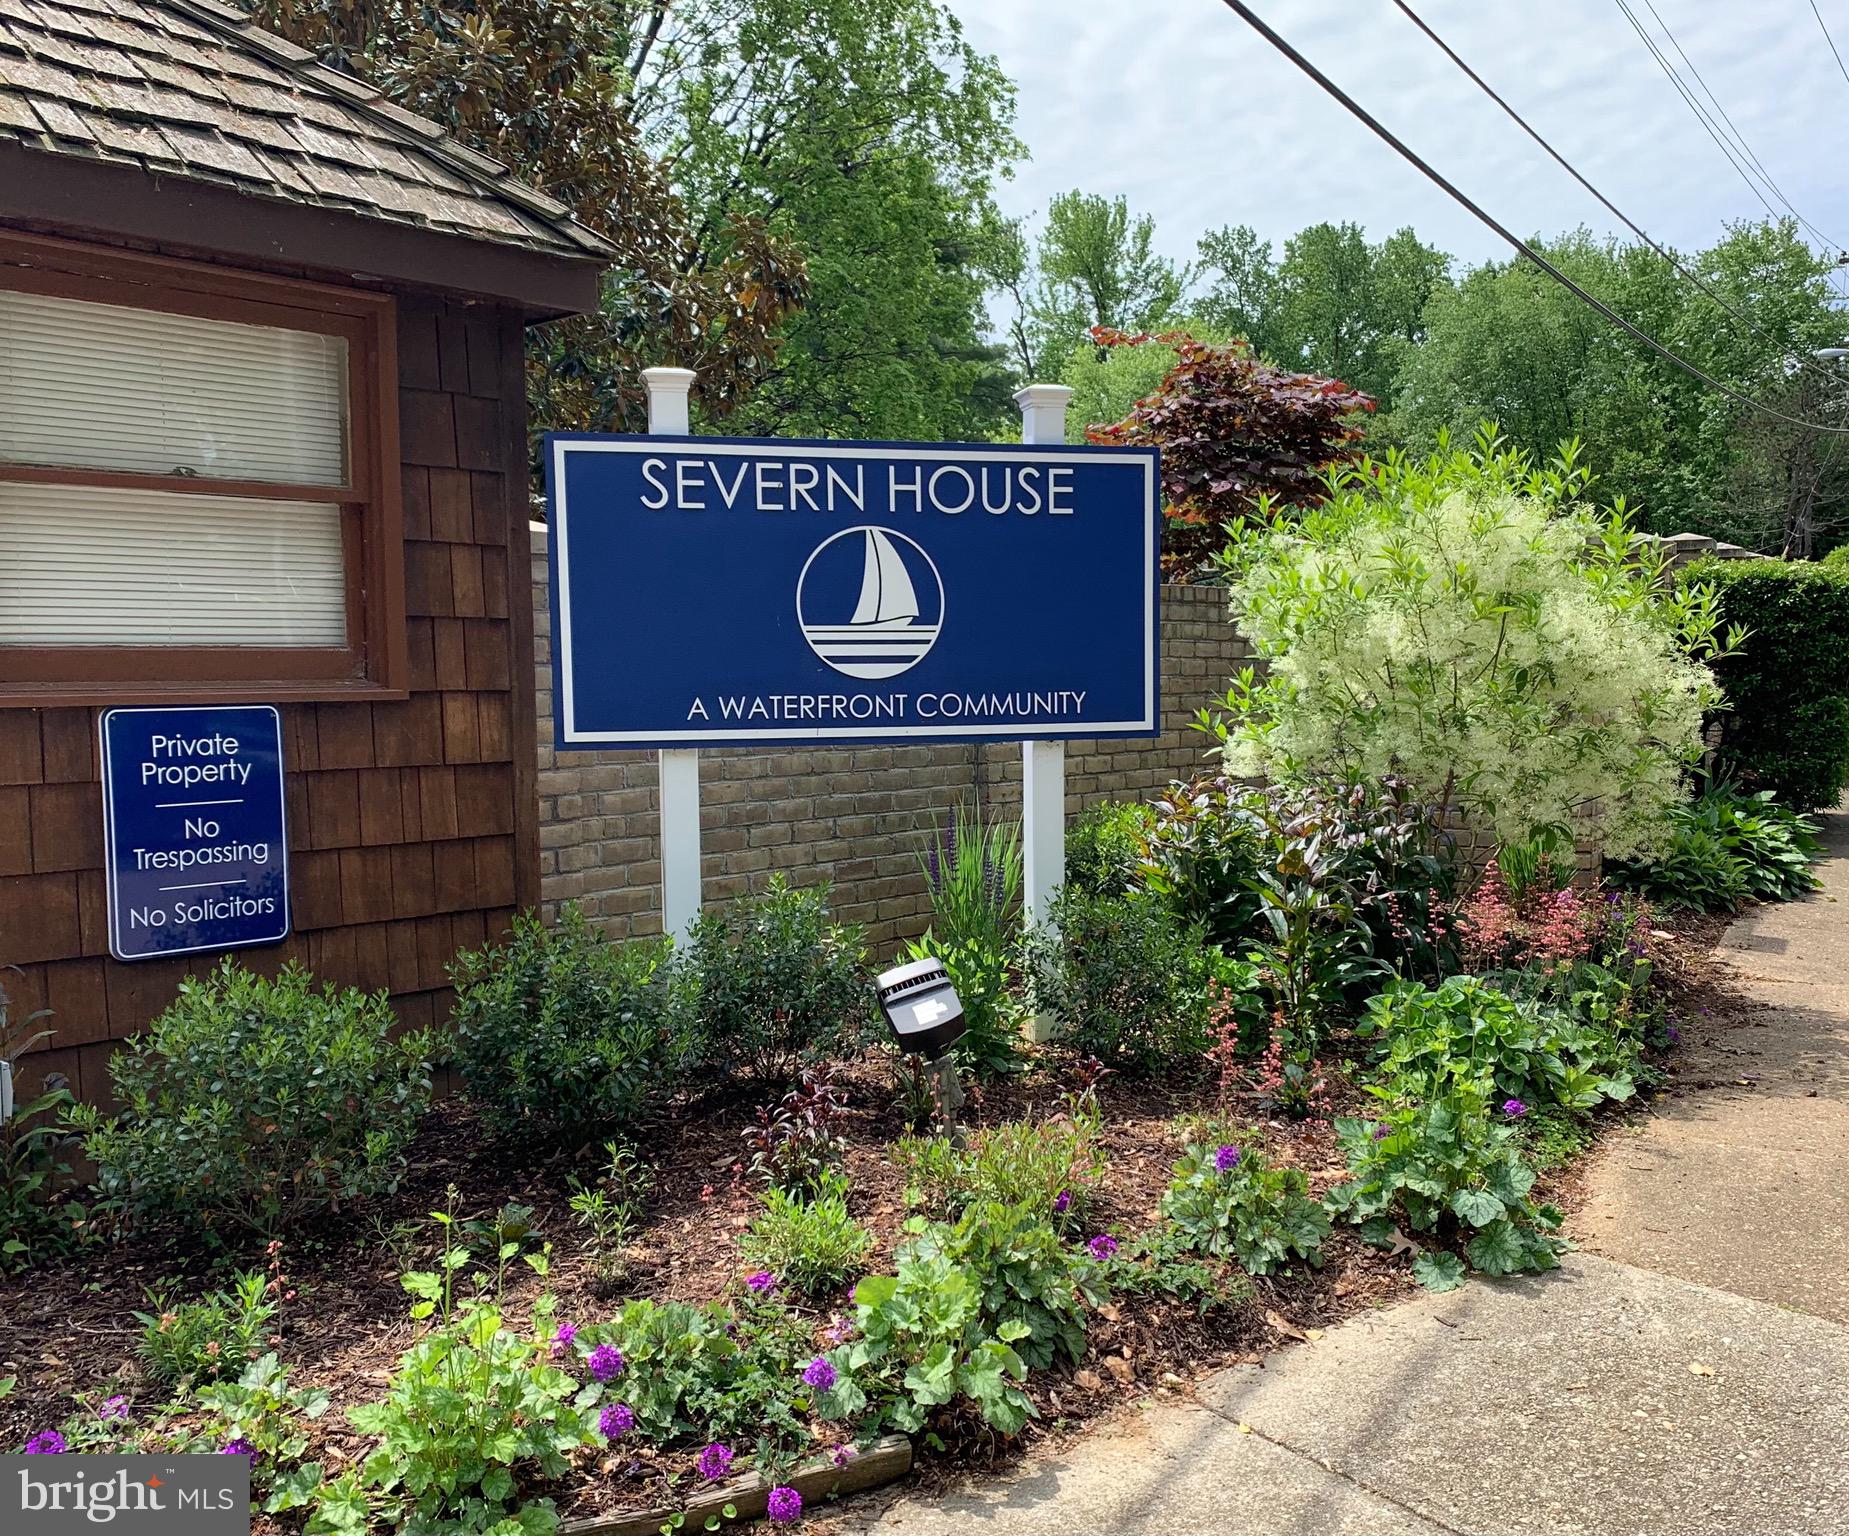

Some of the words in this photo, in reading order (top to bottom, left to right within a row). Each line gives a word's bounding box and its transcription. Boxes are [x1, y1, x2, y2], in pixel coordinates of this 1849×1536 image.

[640, 458, 864, 512] SEVERN
[888, 465, 1075, 515] HOUSE
[687, 697, 709, 721] A
[718, 694, 908, 720] WATERFRONT
[916, 691, 1087, 718] COMMUNITY
[151, 733, 239, 757] Private
[141, 758, 252, 788] Property
[184, 817, 220, 839] No
[133, 840, 268, 871] Trespassing
[130, 906, 166, 929] No
[174, 896, 275, 924] Solicitors
